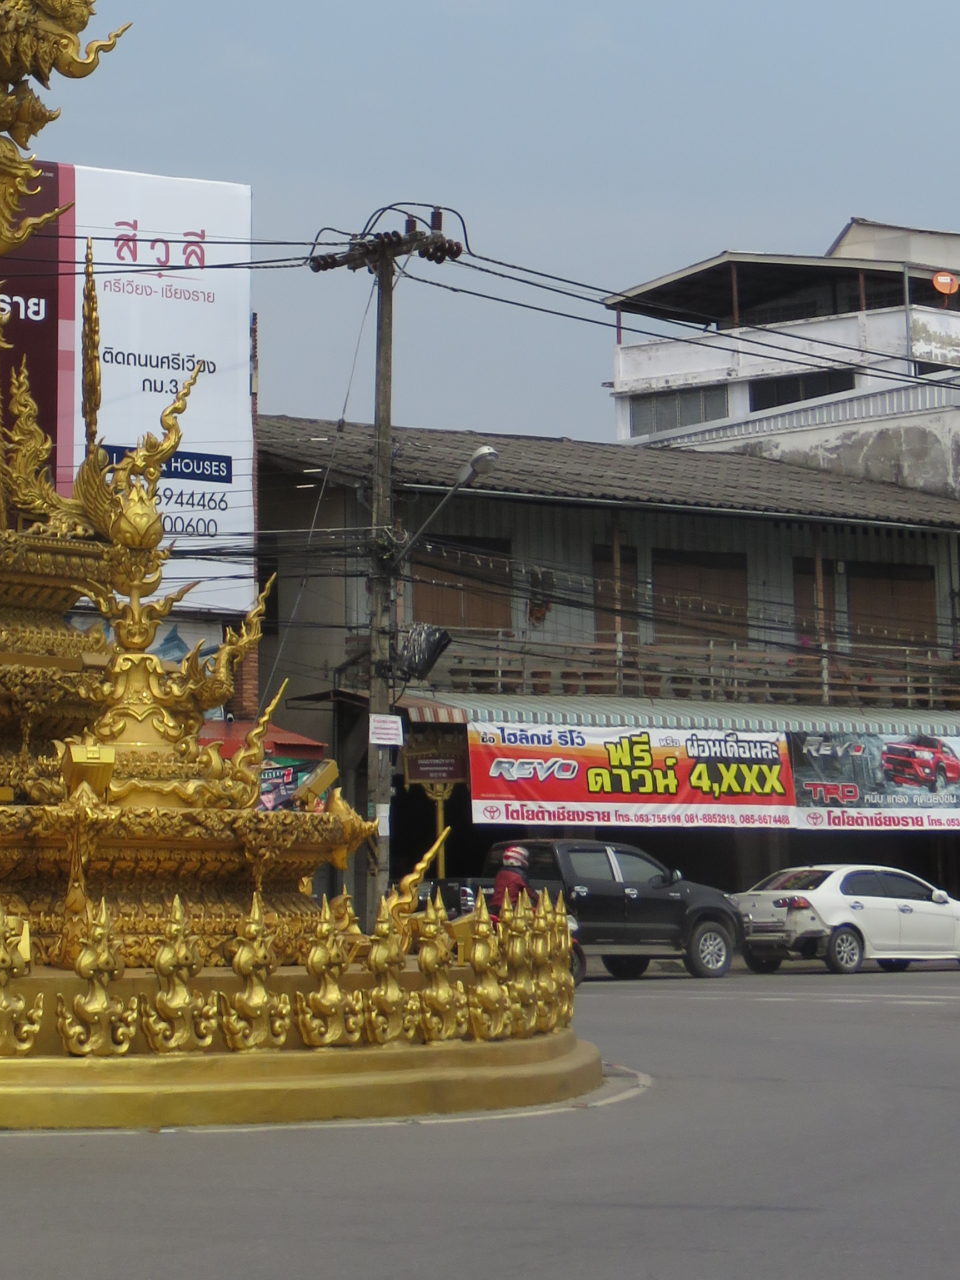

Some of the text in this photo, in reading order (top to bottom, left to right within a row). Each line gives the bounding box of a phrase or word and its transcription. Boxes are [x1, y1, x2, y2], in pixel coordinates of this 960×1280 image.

[141, 377, 179, 395] กม.3
[171, 457, 228, 477] HOUSES
[605, 731, 652, 768] ฟรี
[490, 758, 579, 781] REVO
[587, 757, 678, 794] ดาวน์
[689, 762, 785, 798] 4,XXX
[804, 782, 859, 804] TRD
[504, 804, 611, 823] โตโยต้าเชียงราย
[827, 810, 924, 827] โตโยต้าเชียงราย
